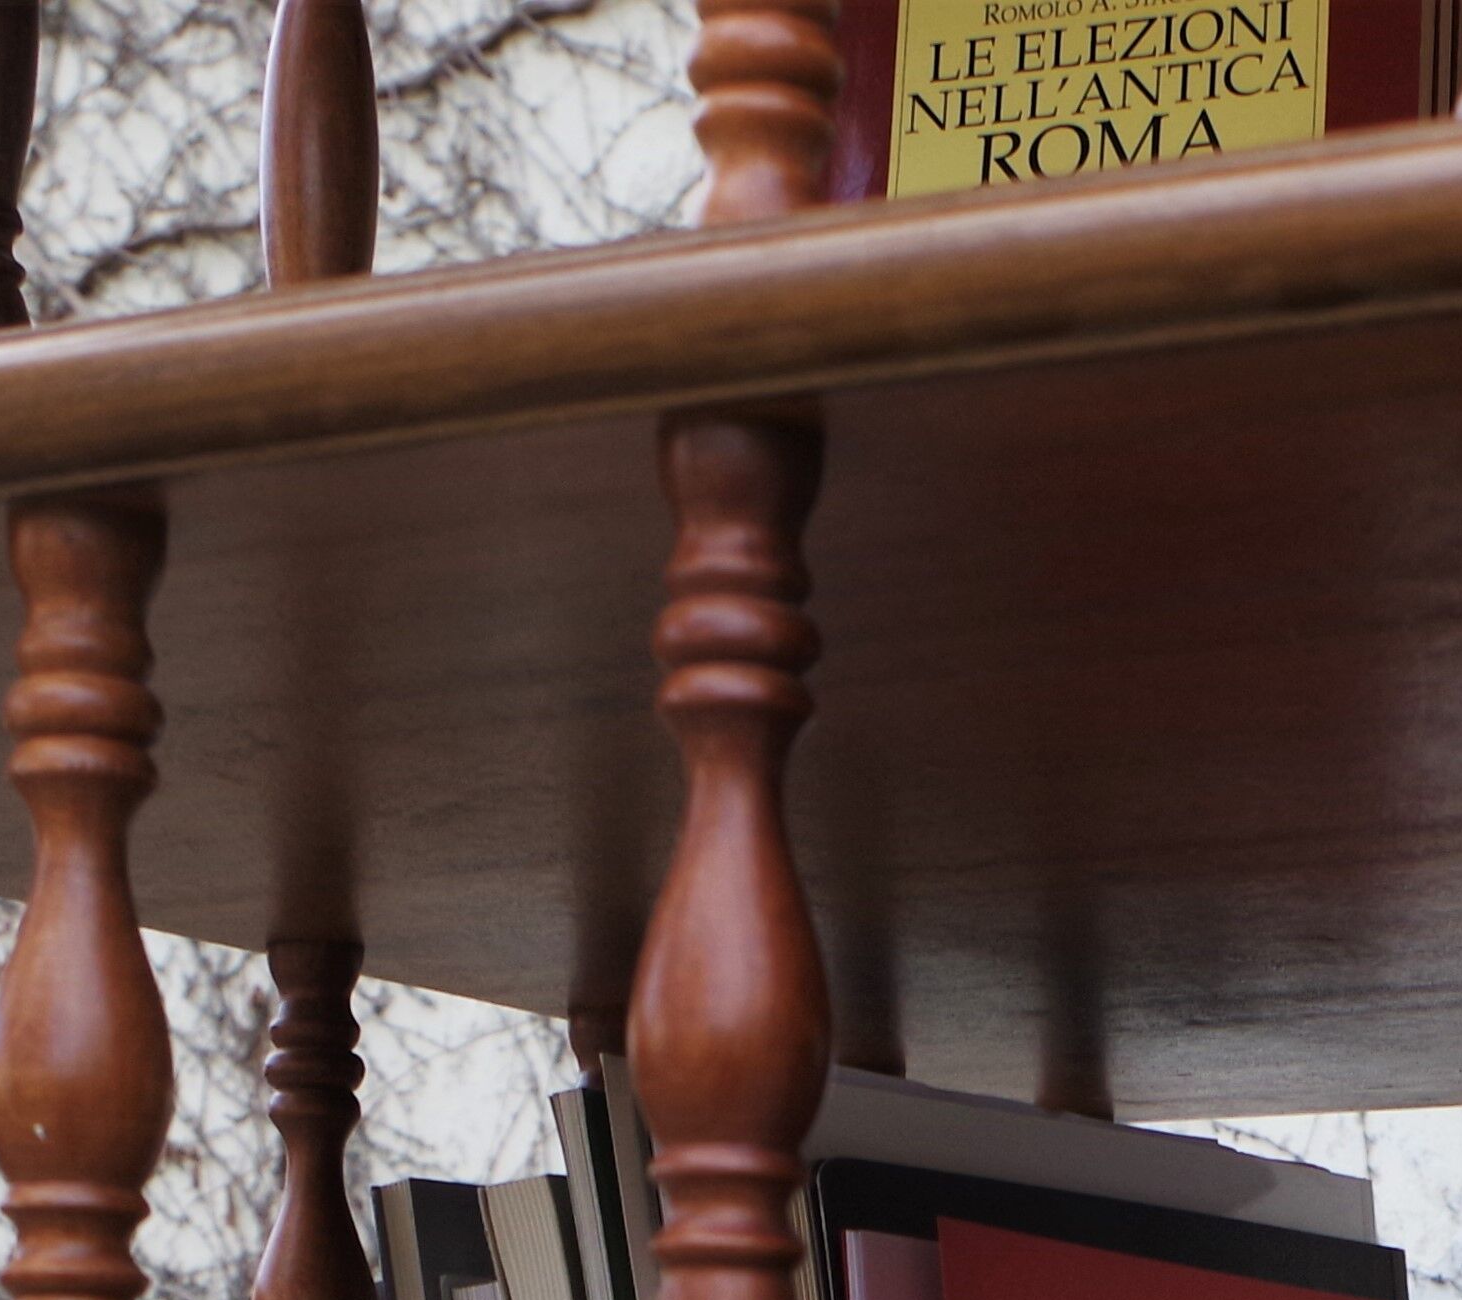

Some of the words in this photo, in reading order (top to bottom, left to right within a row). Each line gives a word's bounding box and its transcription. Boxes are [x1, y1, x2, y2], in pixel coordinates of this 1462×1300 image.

[929, 38, 996, 83] LE
[1013, 0, 1293, 76] ELEZIONI
[904, 48, 1310, 135] NELL'ANTICA
[973, 108, 1226, 187] ROMA
